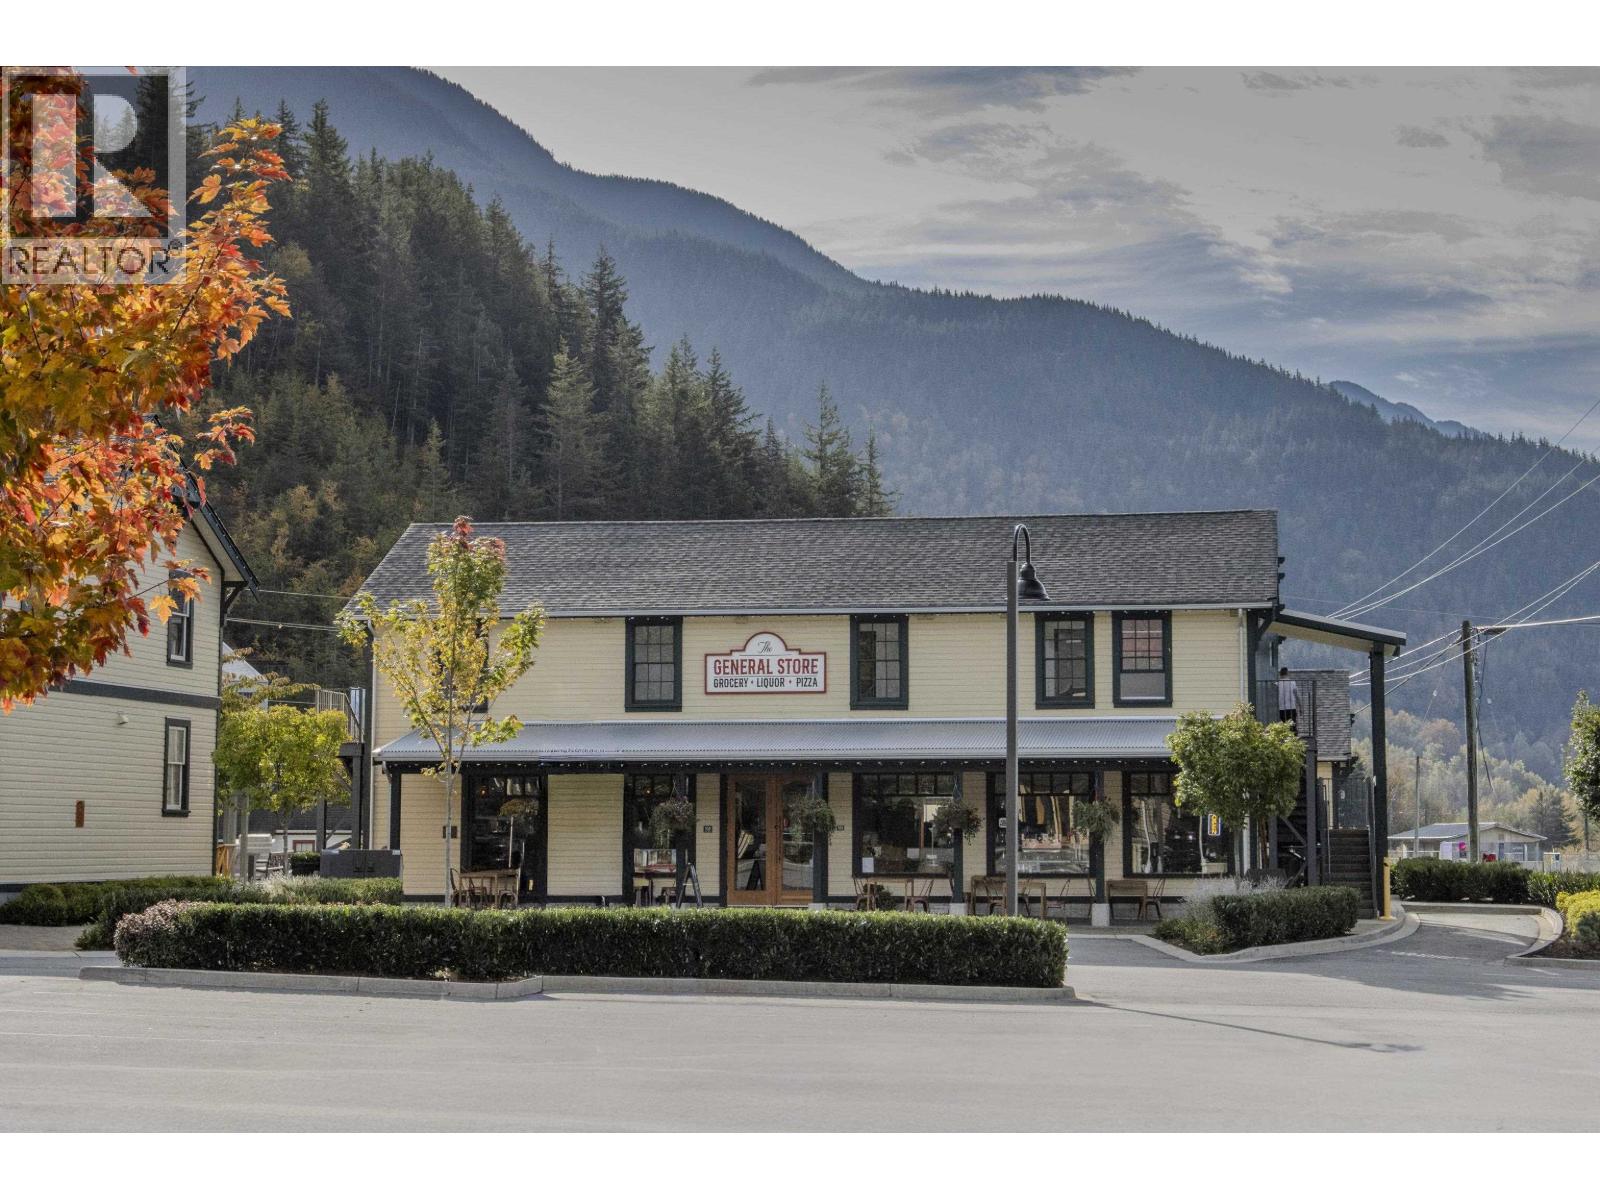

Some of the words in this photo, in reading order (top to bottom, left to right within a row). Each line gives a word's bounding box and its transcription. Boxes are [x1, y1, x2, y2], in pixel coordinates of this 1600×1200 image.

[757, 641, 773, 654] The
[713, 658, 773, 675] GENERAL
[777, 658, 818, 674] STORE
[713, 678, 748, 688] GROCERY
[756, 678, 785, 688] LIQUOR
[796, 677, 818, 688] PIZZA
